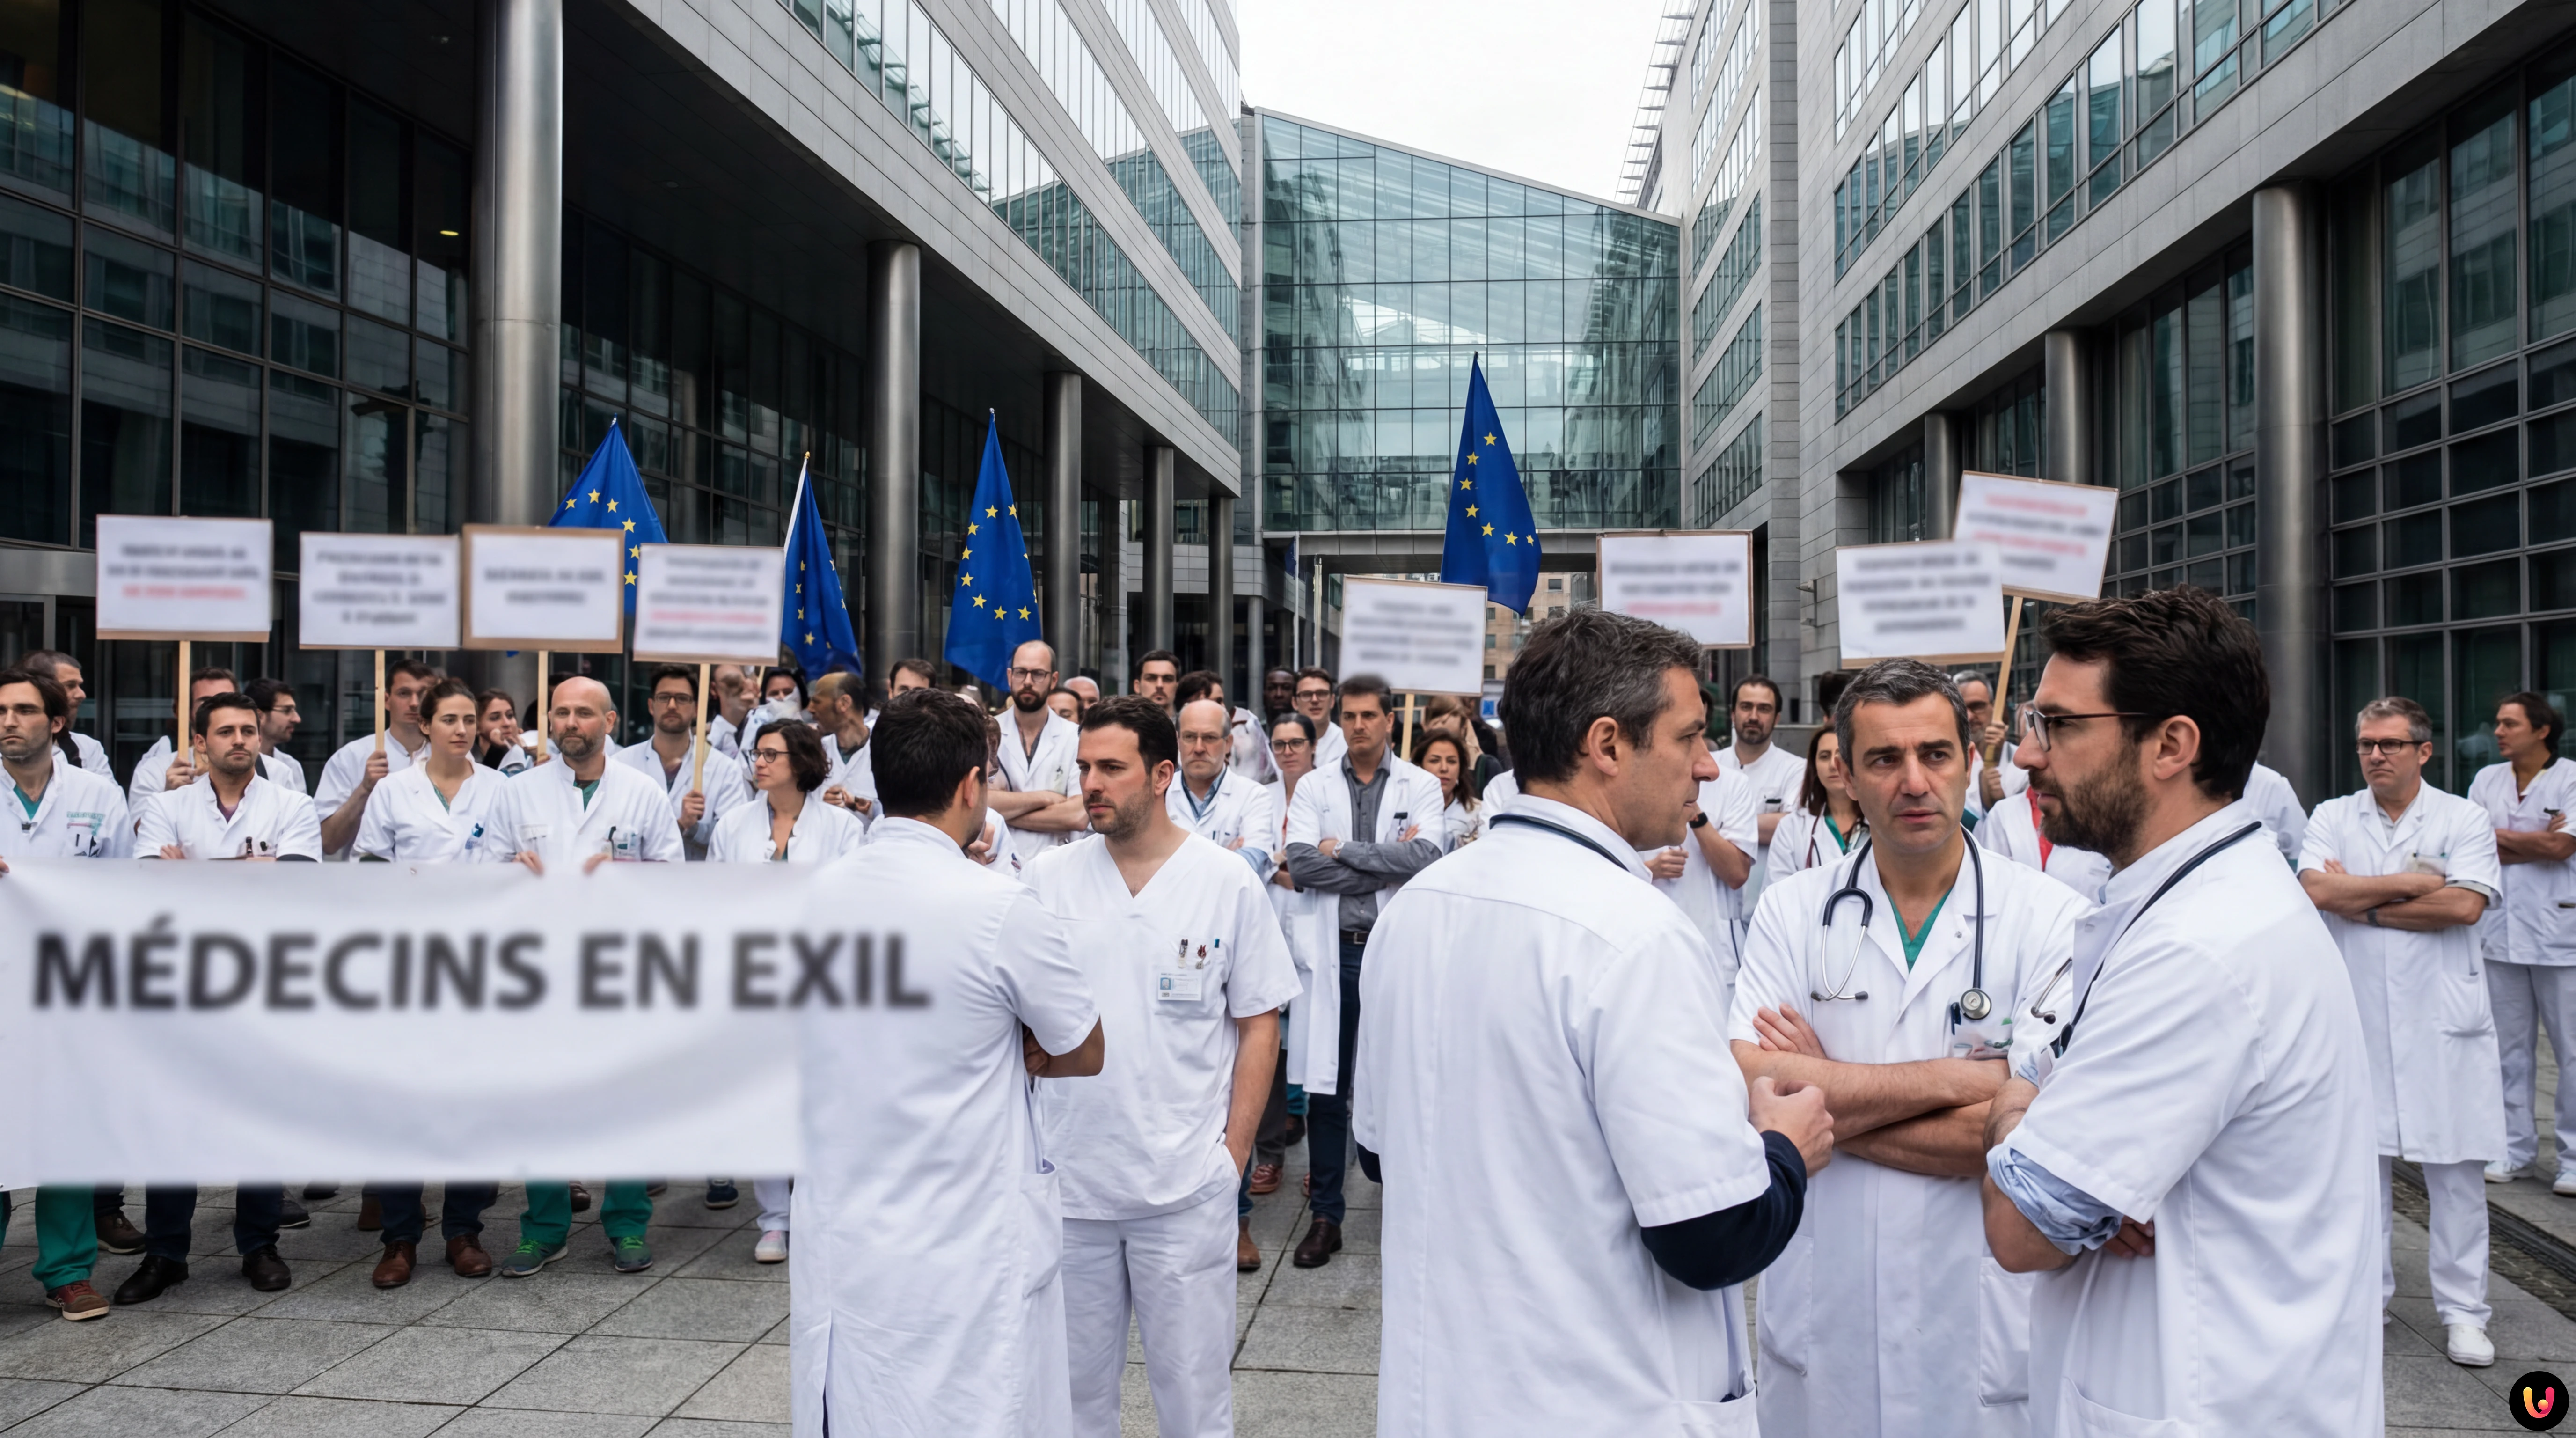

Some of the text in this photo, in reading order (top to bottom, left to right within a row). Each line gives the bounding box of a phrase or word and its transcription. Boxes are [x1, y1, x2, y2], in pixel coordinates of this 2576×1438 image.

[33, 915, 931, 1010] MÉDECINS EN EXIL
